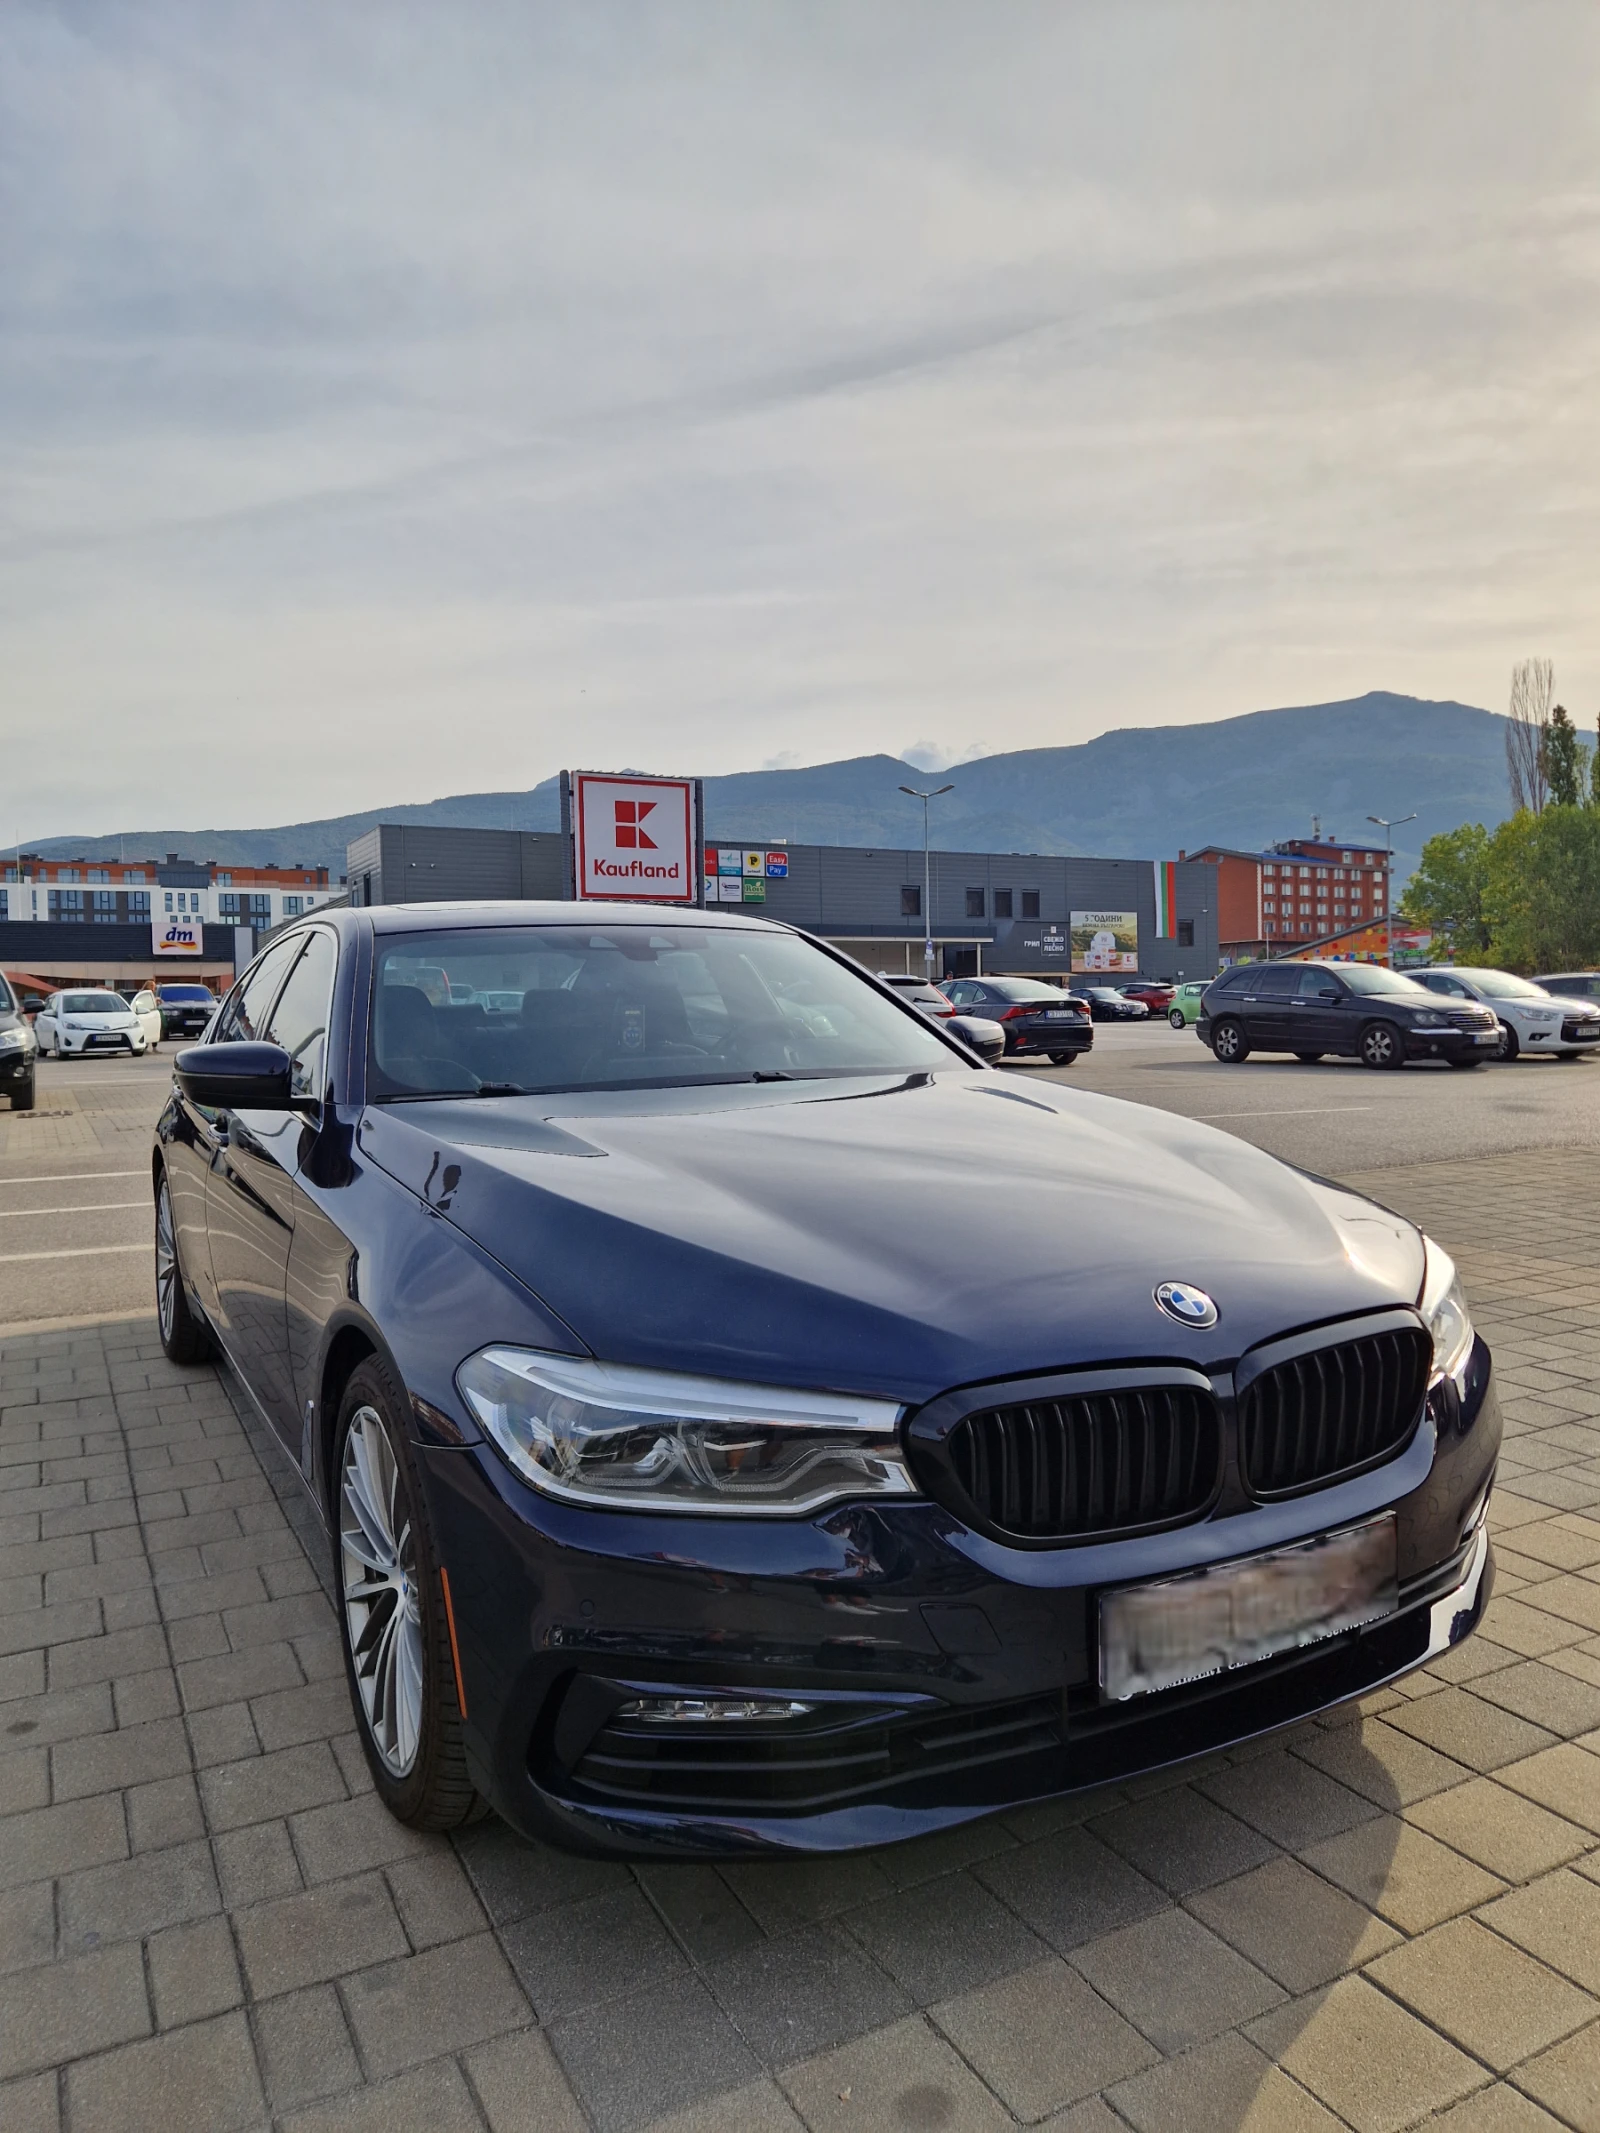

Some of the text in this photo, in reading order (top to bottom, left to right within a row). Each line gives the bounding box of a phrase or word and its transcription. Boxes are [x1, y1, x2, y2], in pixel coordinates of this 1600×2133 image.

[769, 855, 785, 865] Easy
[593, 858, 679, 879] Kaufland
[769, 866, 782, 876] Pay
[1084, 914, 1089, 922] 5
[165, 926, 193, 941] dm
